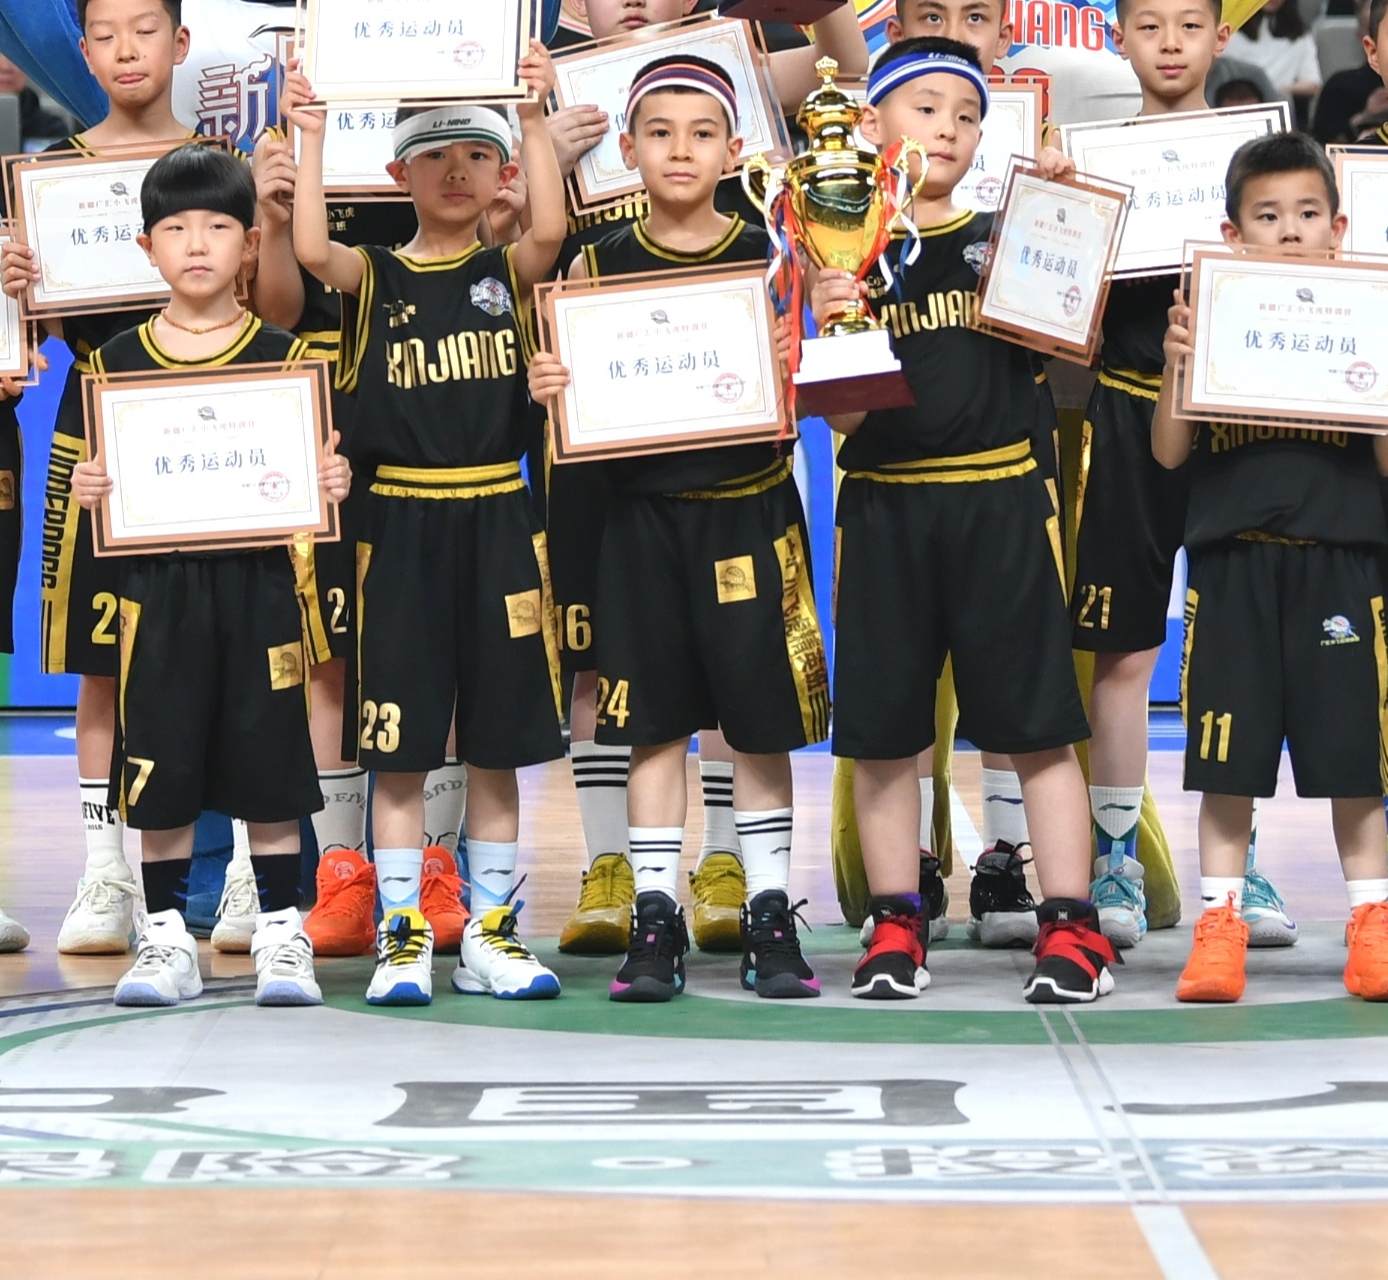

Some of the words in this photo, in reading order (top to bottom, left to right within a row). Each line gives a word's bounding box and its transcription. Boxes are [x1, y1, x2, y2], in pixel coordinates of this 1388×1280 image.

[354, 19, 464, 38] 优秀运动员
[433, 118, 472, 129] LI-NING
[1020, 245, 1079, 280] 优秀运动员
[1244, 329, 1357, 356] 优秀运动员
[609, 349, 720, 380] 优秀运动员
[154, 447, 267, 476] 优秀运动员
[1078, 584, 1112, 630] 21
[596, 677, 630, 729] 24
[360, 700, 401, 754] 23
[1200, 711, 1232, 763] 11
